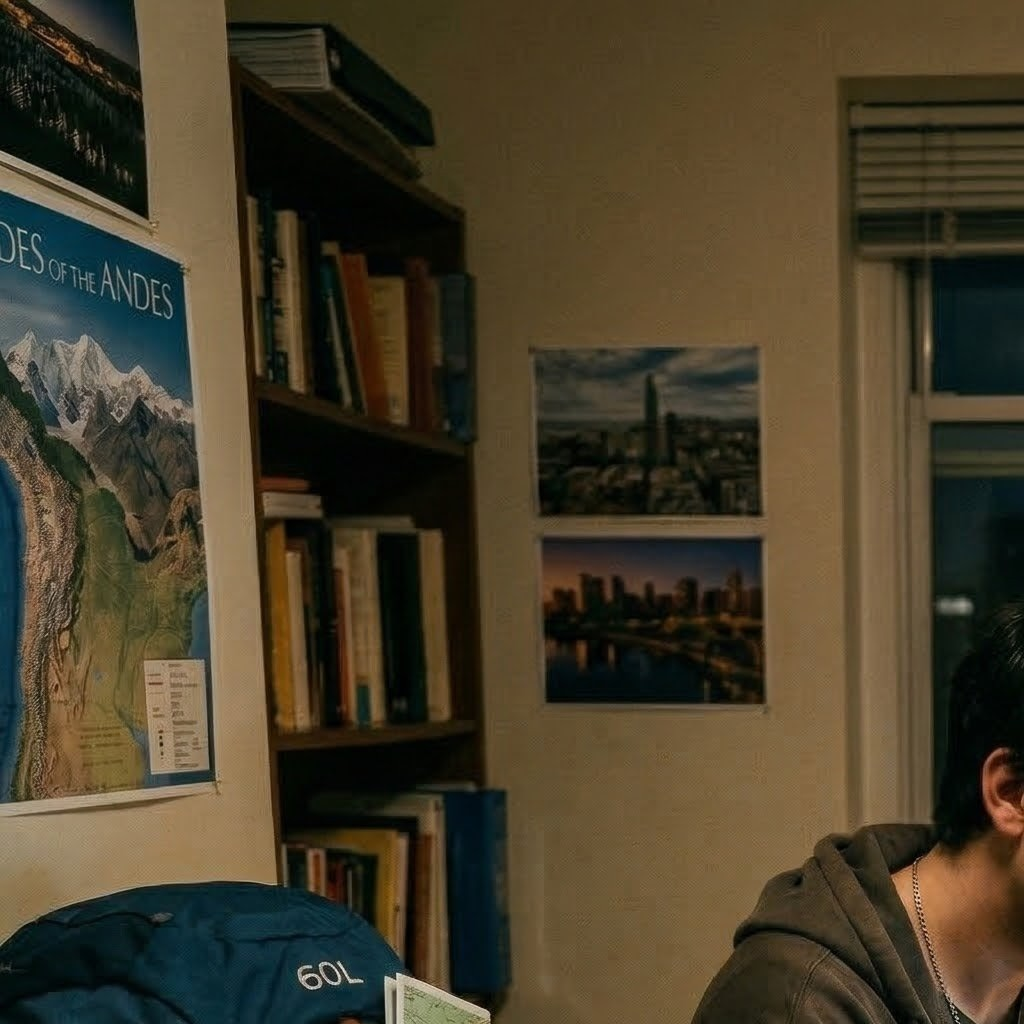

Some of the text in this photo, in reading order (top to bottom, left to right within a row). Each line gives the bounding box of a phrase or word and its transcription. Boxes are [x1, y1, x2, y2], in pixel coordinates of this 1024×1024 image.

[48, 258, 68, 285] OF
[69, 266, 97, 295] THE
[100, 261, 174, 320] ANDES
[297, 961, 365, 991] 60L
